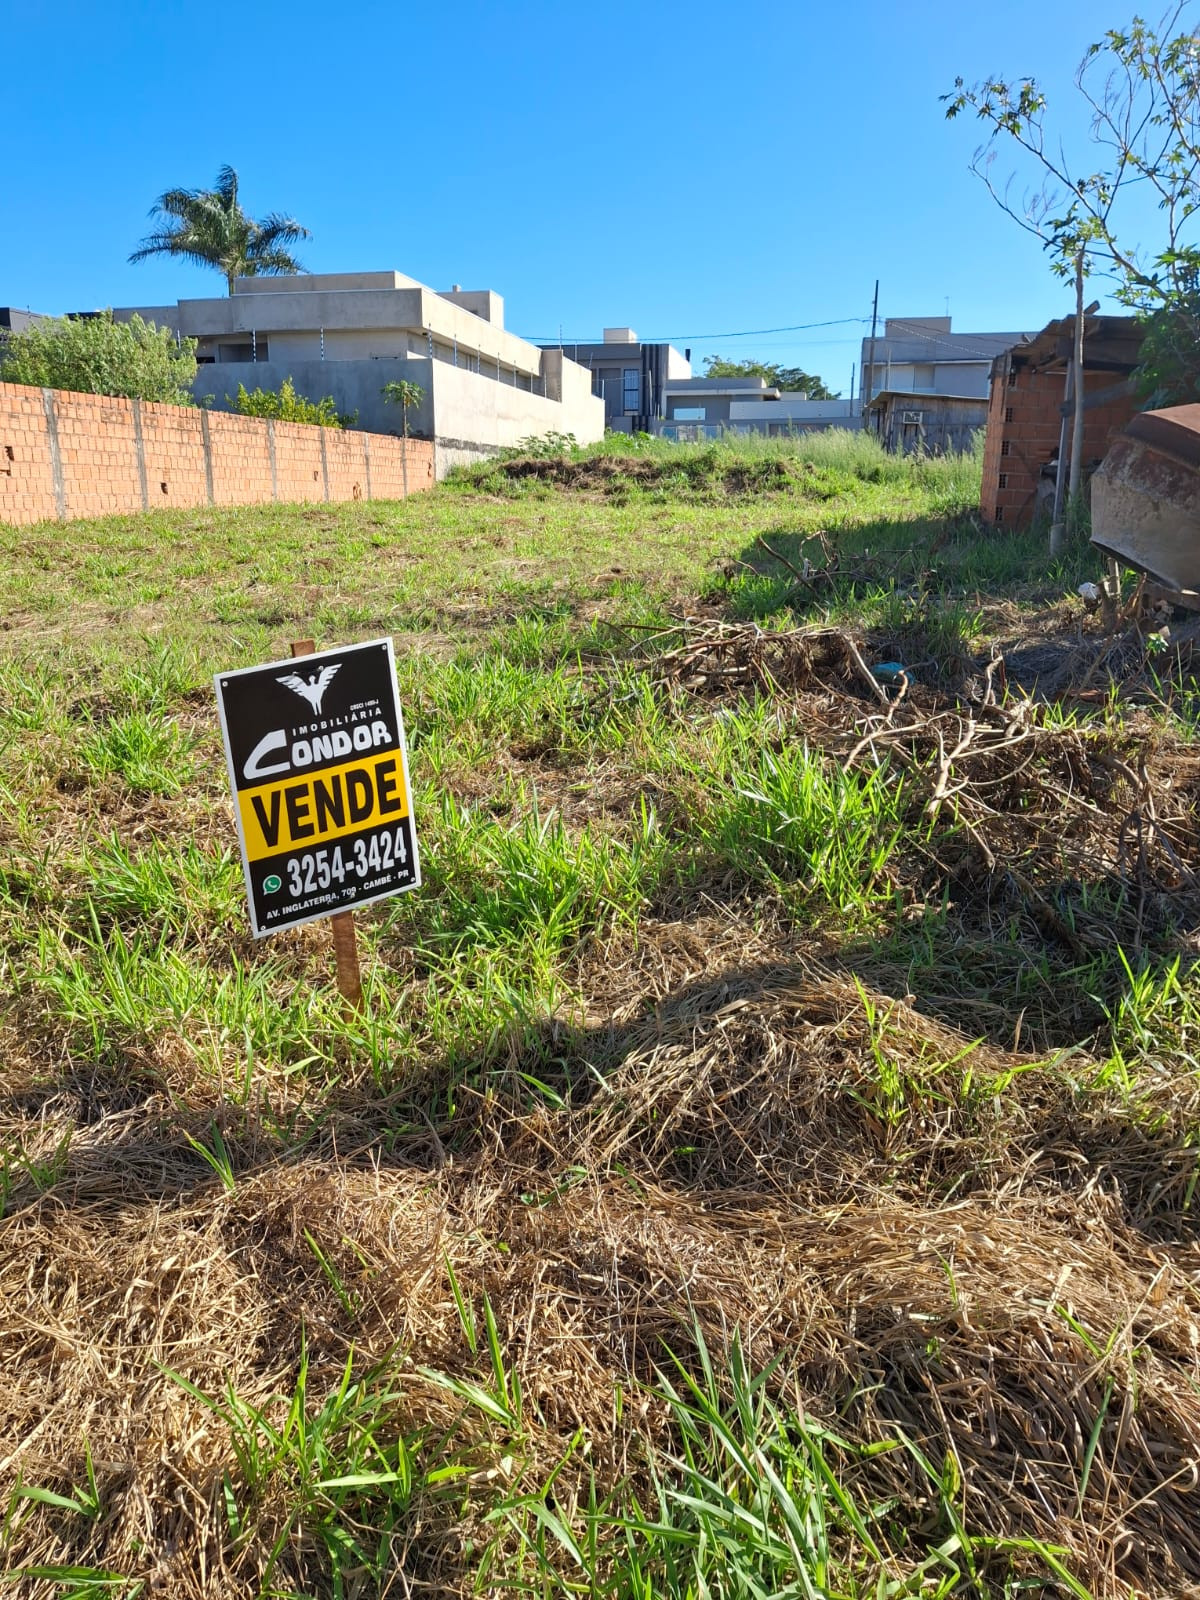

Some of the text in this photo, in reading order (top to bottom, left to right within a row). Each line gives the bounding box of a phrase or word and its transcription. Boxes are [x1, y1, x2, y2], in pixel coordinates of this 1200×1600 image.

[243, 720, 393, 780] CONDOR
[292, 706, 382, 736] IMOBILIÁRIA
[251, 759, 402, 848] VENDE
[287, 826, 408, 897] 3254-3424
[266, 909, 281, 920] AV.
[282, 893, 340, 914] INGLATERRA,
[398, 869, 409, 880] PR
